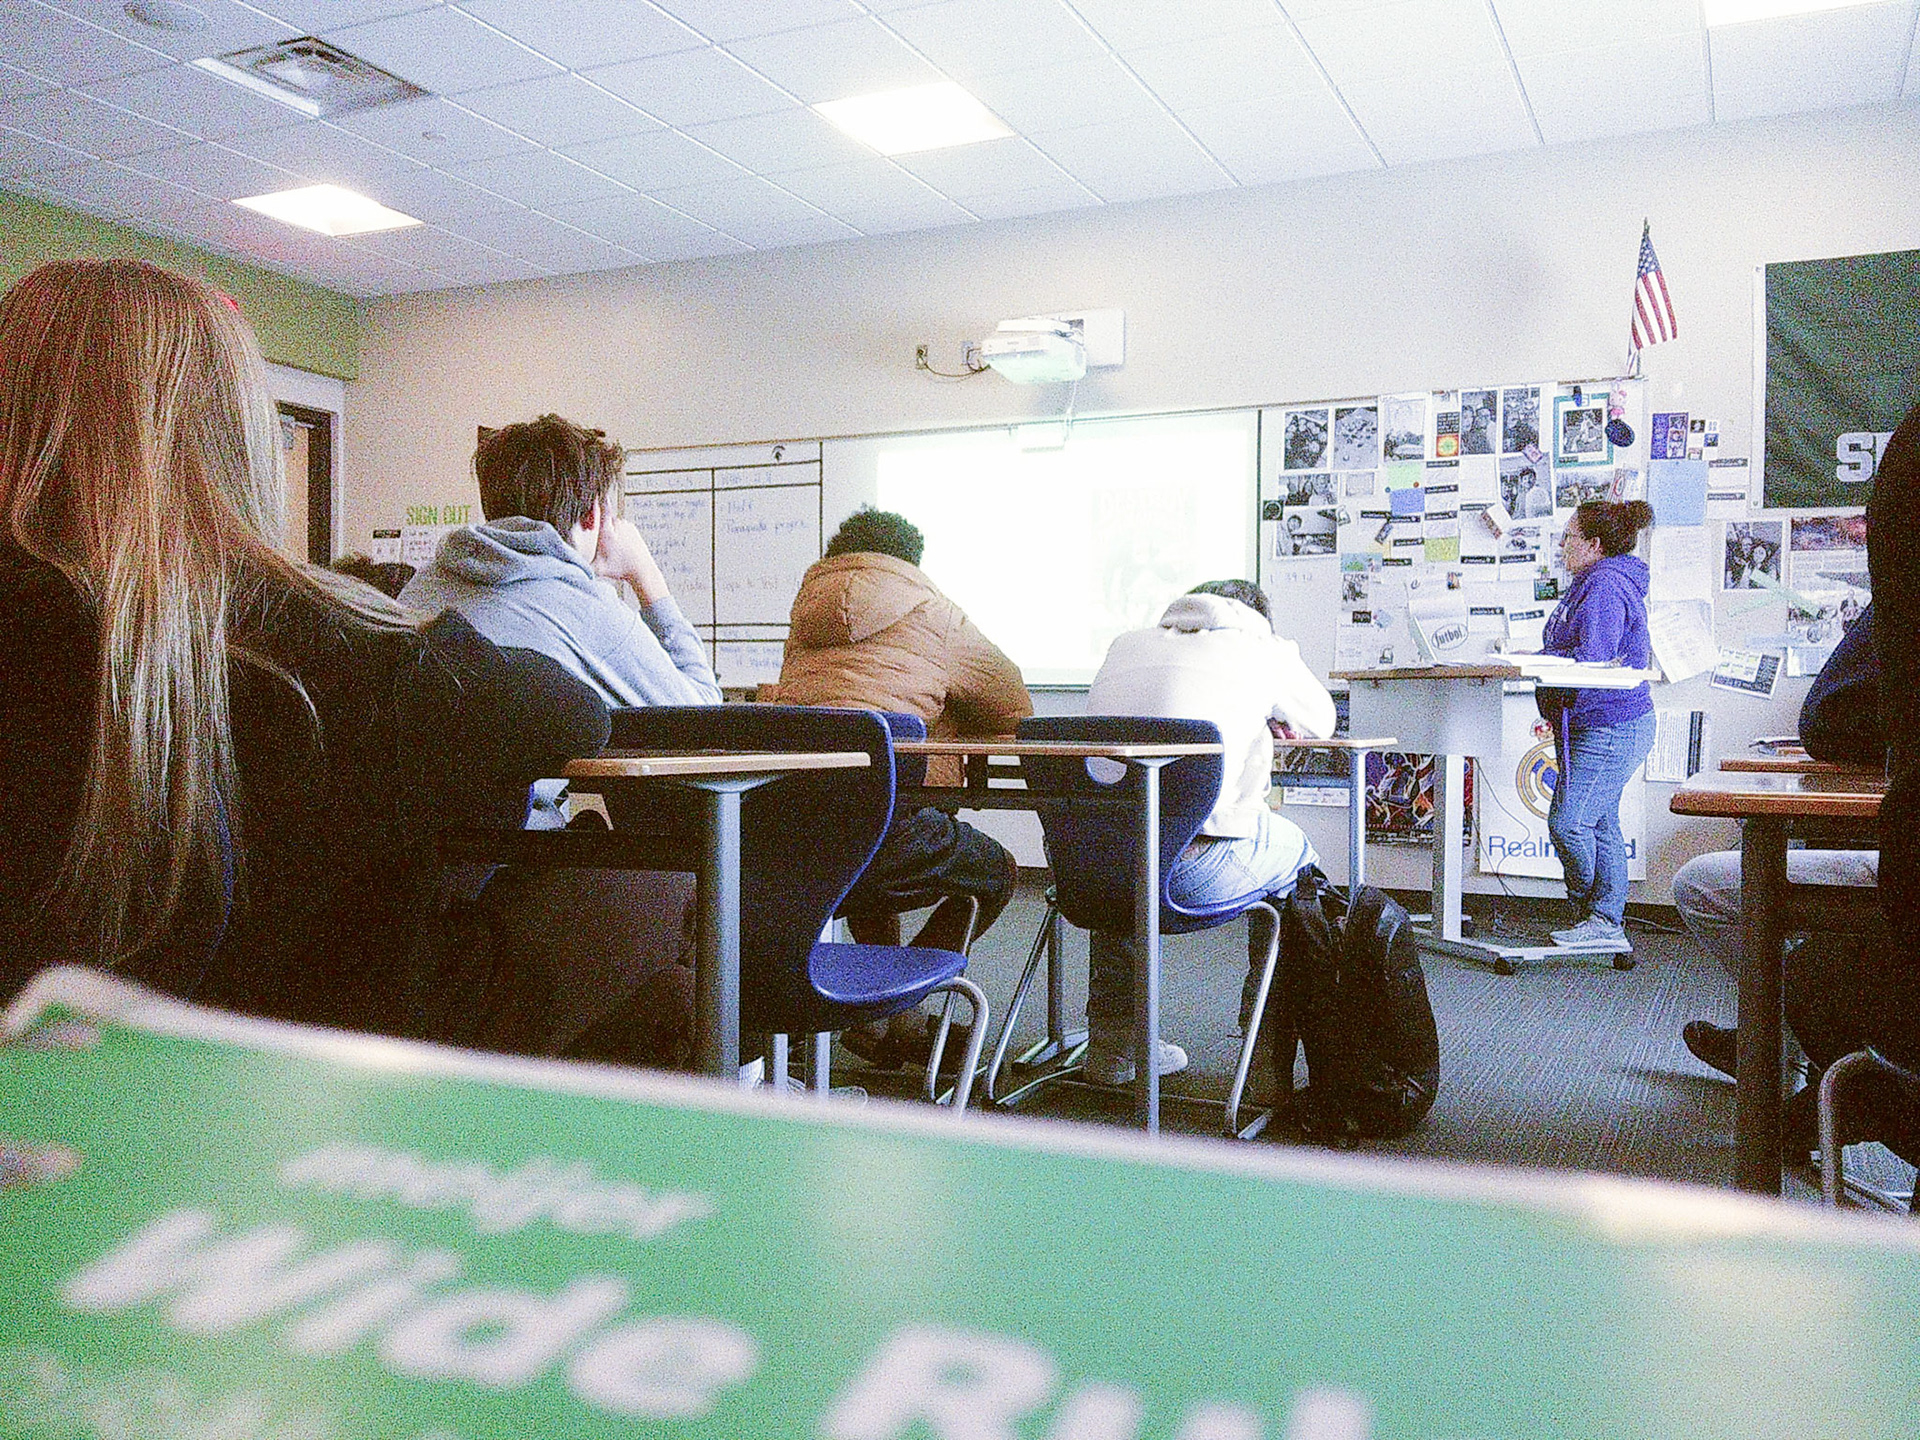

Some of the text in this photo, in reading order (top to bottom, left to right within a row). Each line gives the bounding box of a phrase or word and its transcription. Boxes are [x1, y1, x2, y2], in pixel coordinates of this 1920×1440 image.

[405, 504, 471, 525] SIGN OUT
[58, 1206, 758, 1417] Wide
